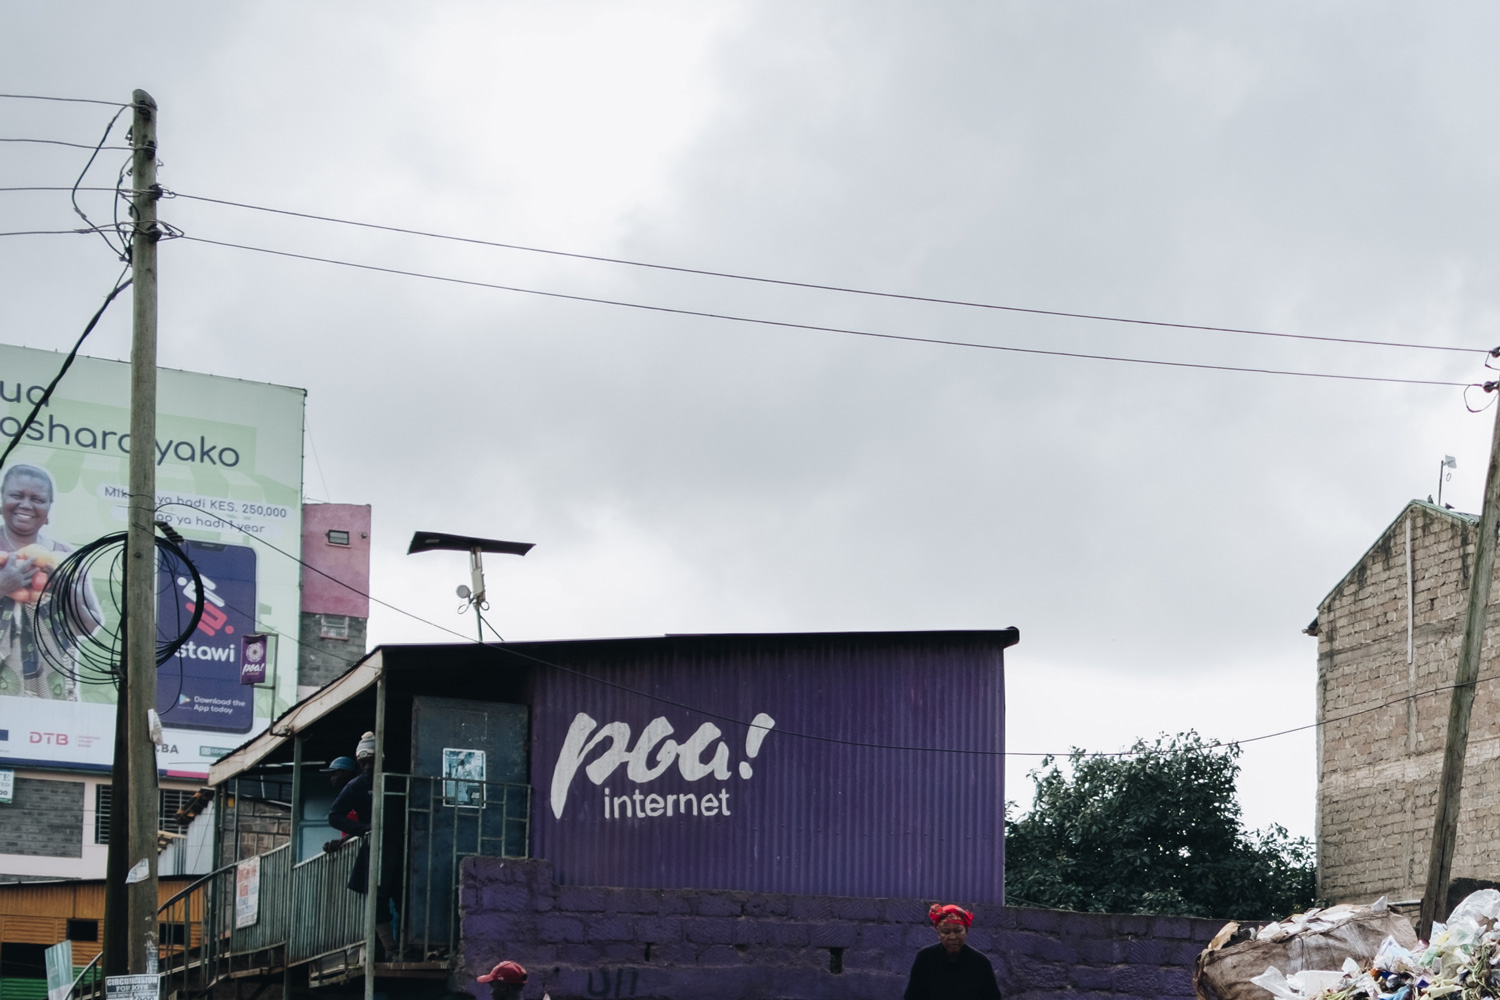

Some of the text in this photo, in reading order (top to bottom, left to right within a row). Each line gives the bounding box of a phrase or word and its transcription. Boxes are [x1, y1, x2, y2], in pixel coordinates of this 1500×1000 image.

[209, 499, 238, 513] KES.
[242, 503, 287, 519] 250,000
[176, 515, 192, 526] ya
[193, 696, 246, 707] Download the
[193, 704, 210, 713] App
[210, 705, 233, 715] today
[29, 731, 69, 746] DTB
[550, 712, 776, 820] poa!
[603, 787, 731, 819] internet
